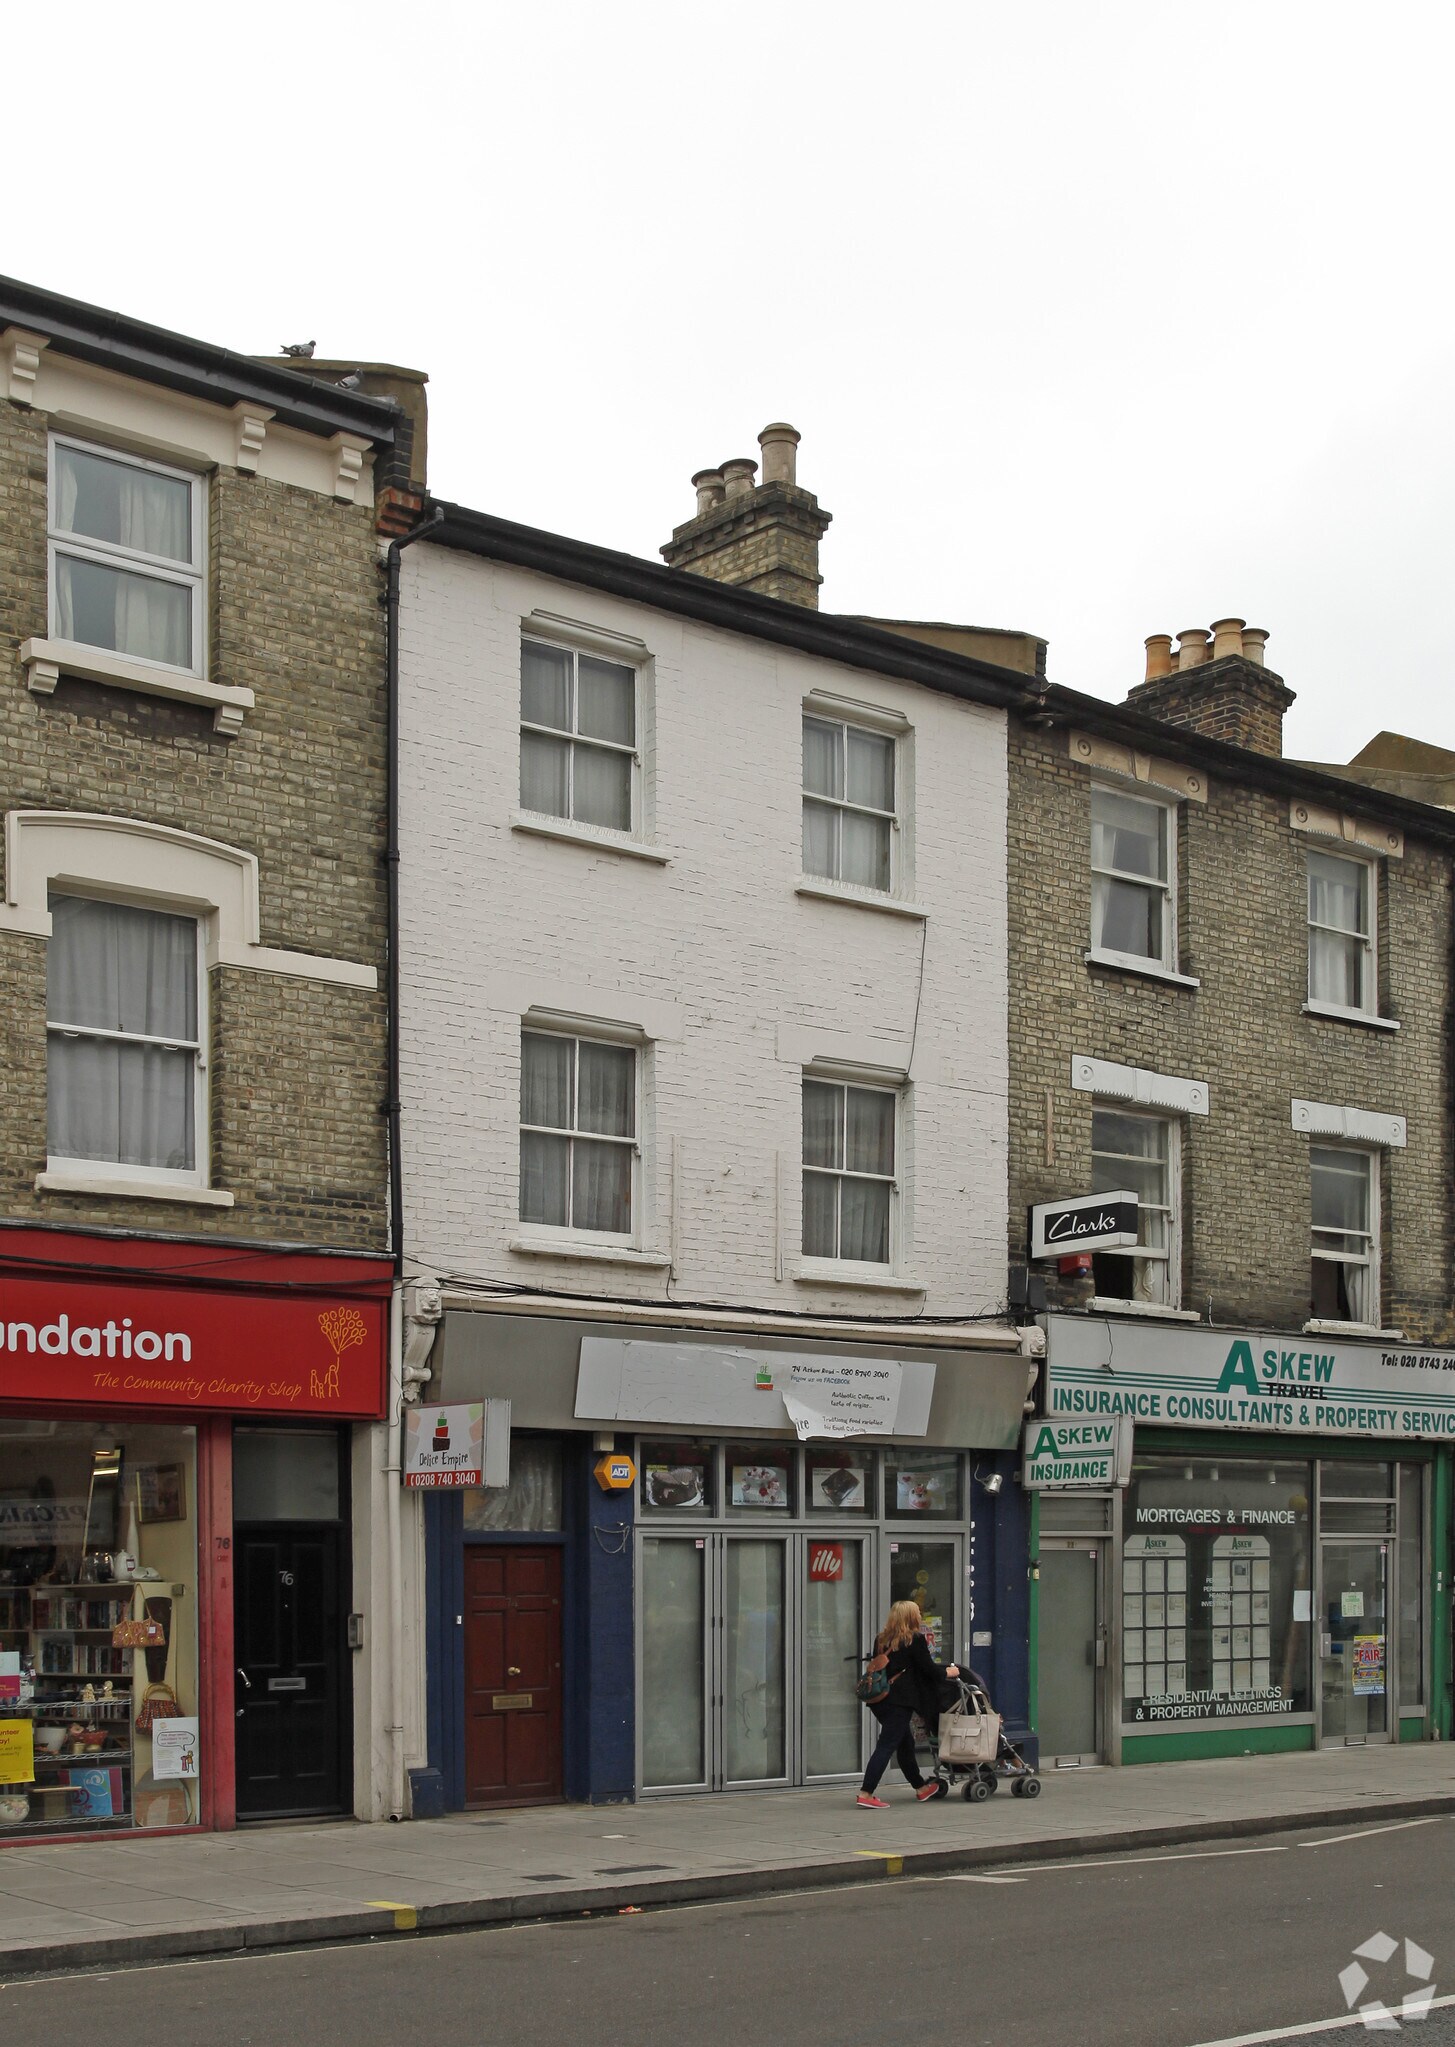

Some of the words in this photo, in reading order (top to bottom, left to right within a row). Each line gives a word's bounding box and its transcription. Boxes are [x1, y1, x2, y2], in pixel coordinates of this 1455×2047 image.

[1048, 1212, 1116, 1240] Clarks
[0, 1314, 192, 1363] ndation
[1216, 1340, 1335, 1395] ASKEW
[1381, 1353, 1398, 1367] Tel:
[1400, 1355, 1417, 1368] 020
[1419, 1357, 1440, 1370] 8743
[841, 1368, 854, 1376] 020
[855, 1369, 872, 1377] 8740
[873, 1371, 889, 1379] 3040
[93, 1372, 119, 1388] The
[123, 1375, 205, 1400] Community
[208, 1378, 264, 1403] Charity
[267, 1382, 302, 1402] Shop
[1266, 1382, 1328, 1400] TRAVEL
[1053, 1388, 1161, 1416] INSURANCE
[1166, 1395, 1293, 1425] CONSULTANTS
[1298, 1404, 1310, 1426] &
[1316, 1405, 1398, 1431] PROPERTY
[1032, 1425, 1114, 1460] ASKEW
[419, 1452, 439, 1467] Delice
[441, 1451, 469, 1471] Empire
[437, 1473, 453, 1486] 740
[454, 1471, 476, 1485] 3040
[611, 1464, 630, 1478] ADT
[1030, 1460, 1109, 1481] INSURANCE
[1136, 1508, 1222, 1524] MORTGAGES
[1226, 1509, 1236, 1524] &
[1241, 1509, 1296, 1525] FINANCE
[1144, 1536, 1167, 1550] ASKEW
[1231, 1536, 1252, 1550] ASKEW
[812, 1549, 841, 1578] illy
[278, 1570, 294, 1586] 76
[1359, 1649, 1380, 1662] FAIR
[1149, 1689, 1225, 1705] RESIDENTIAL
[1135, 1707, 1145, 1720] &
[1150, 1704, 1211, 1720] PROPERTY
[1216, 1699, 1294, 1716] MANAGEMENT
